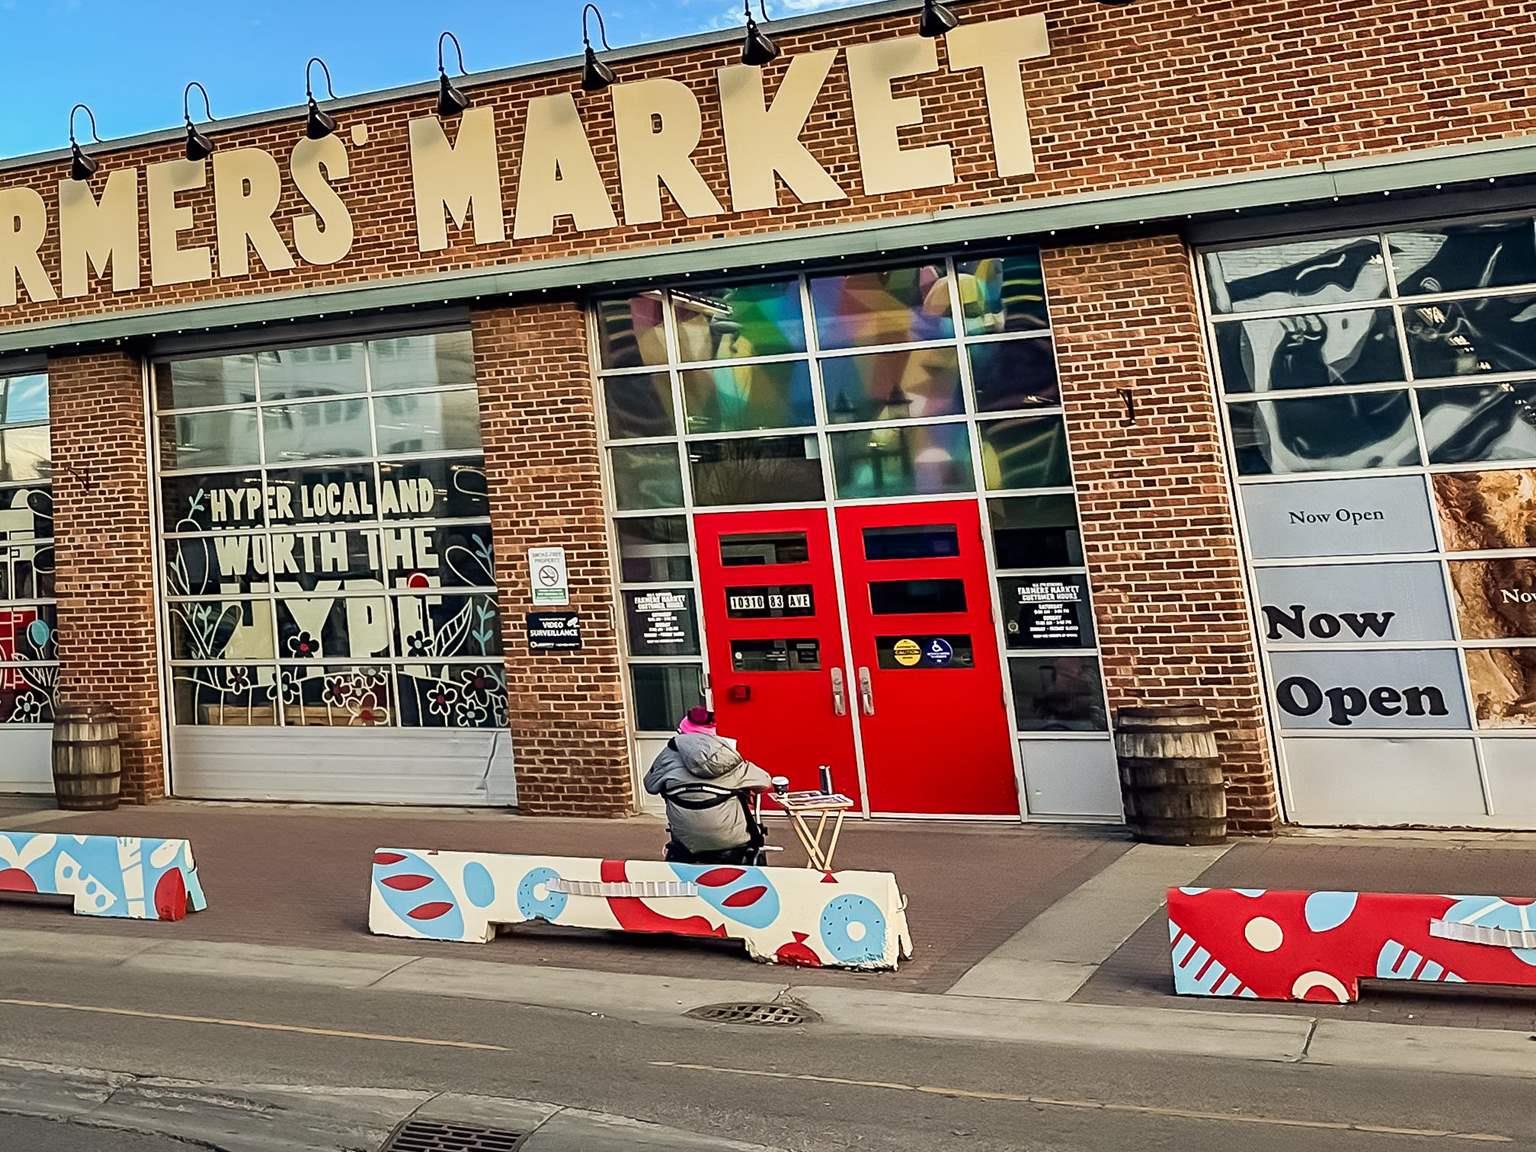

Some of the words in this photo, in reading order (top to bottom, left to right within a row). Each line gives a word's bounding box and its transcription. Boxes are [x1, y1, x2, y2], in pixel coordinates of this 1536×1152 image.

[408, 13, 1051, 252] MARKET
[210, 486, 294, 522] HYPER
[301, 481, 373, 518] LOCAL
[381, 478, 434, 514] AND
[1289, 510, 1331, 525] Now
[1335, 508, 1384, 526] Open
[212, 524, 349, 576] WORTH
[360, 518, 440, 570] THE
[731, 596, 764, 609] 10310
[769, 596, 783, 608] 83
[789, 594, 810, 608] AVE
[529, 629, 578, 637] SURVEILLANCE
[542, 621, 564, 629] VIDEO
[1261, 604, 1395, 639] Now
[1276, 676, 1449, 726] Open
